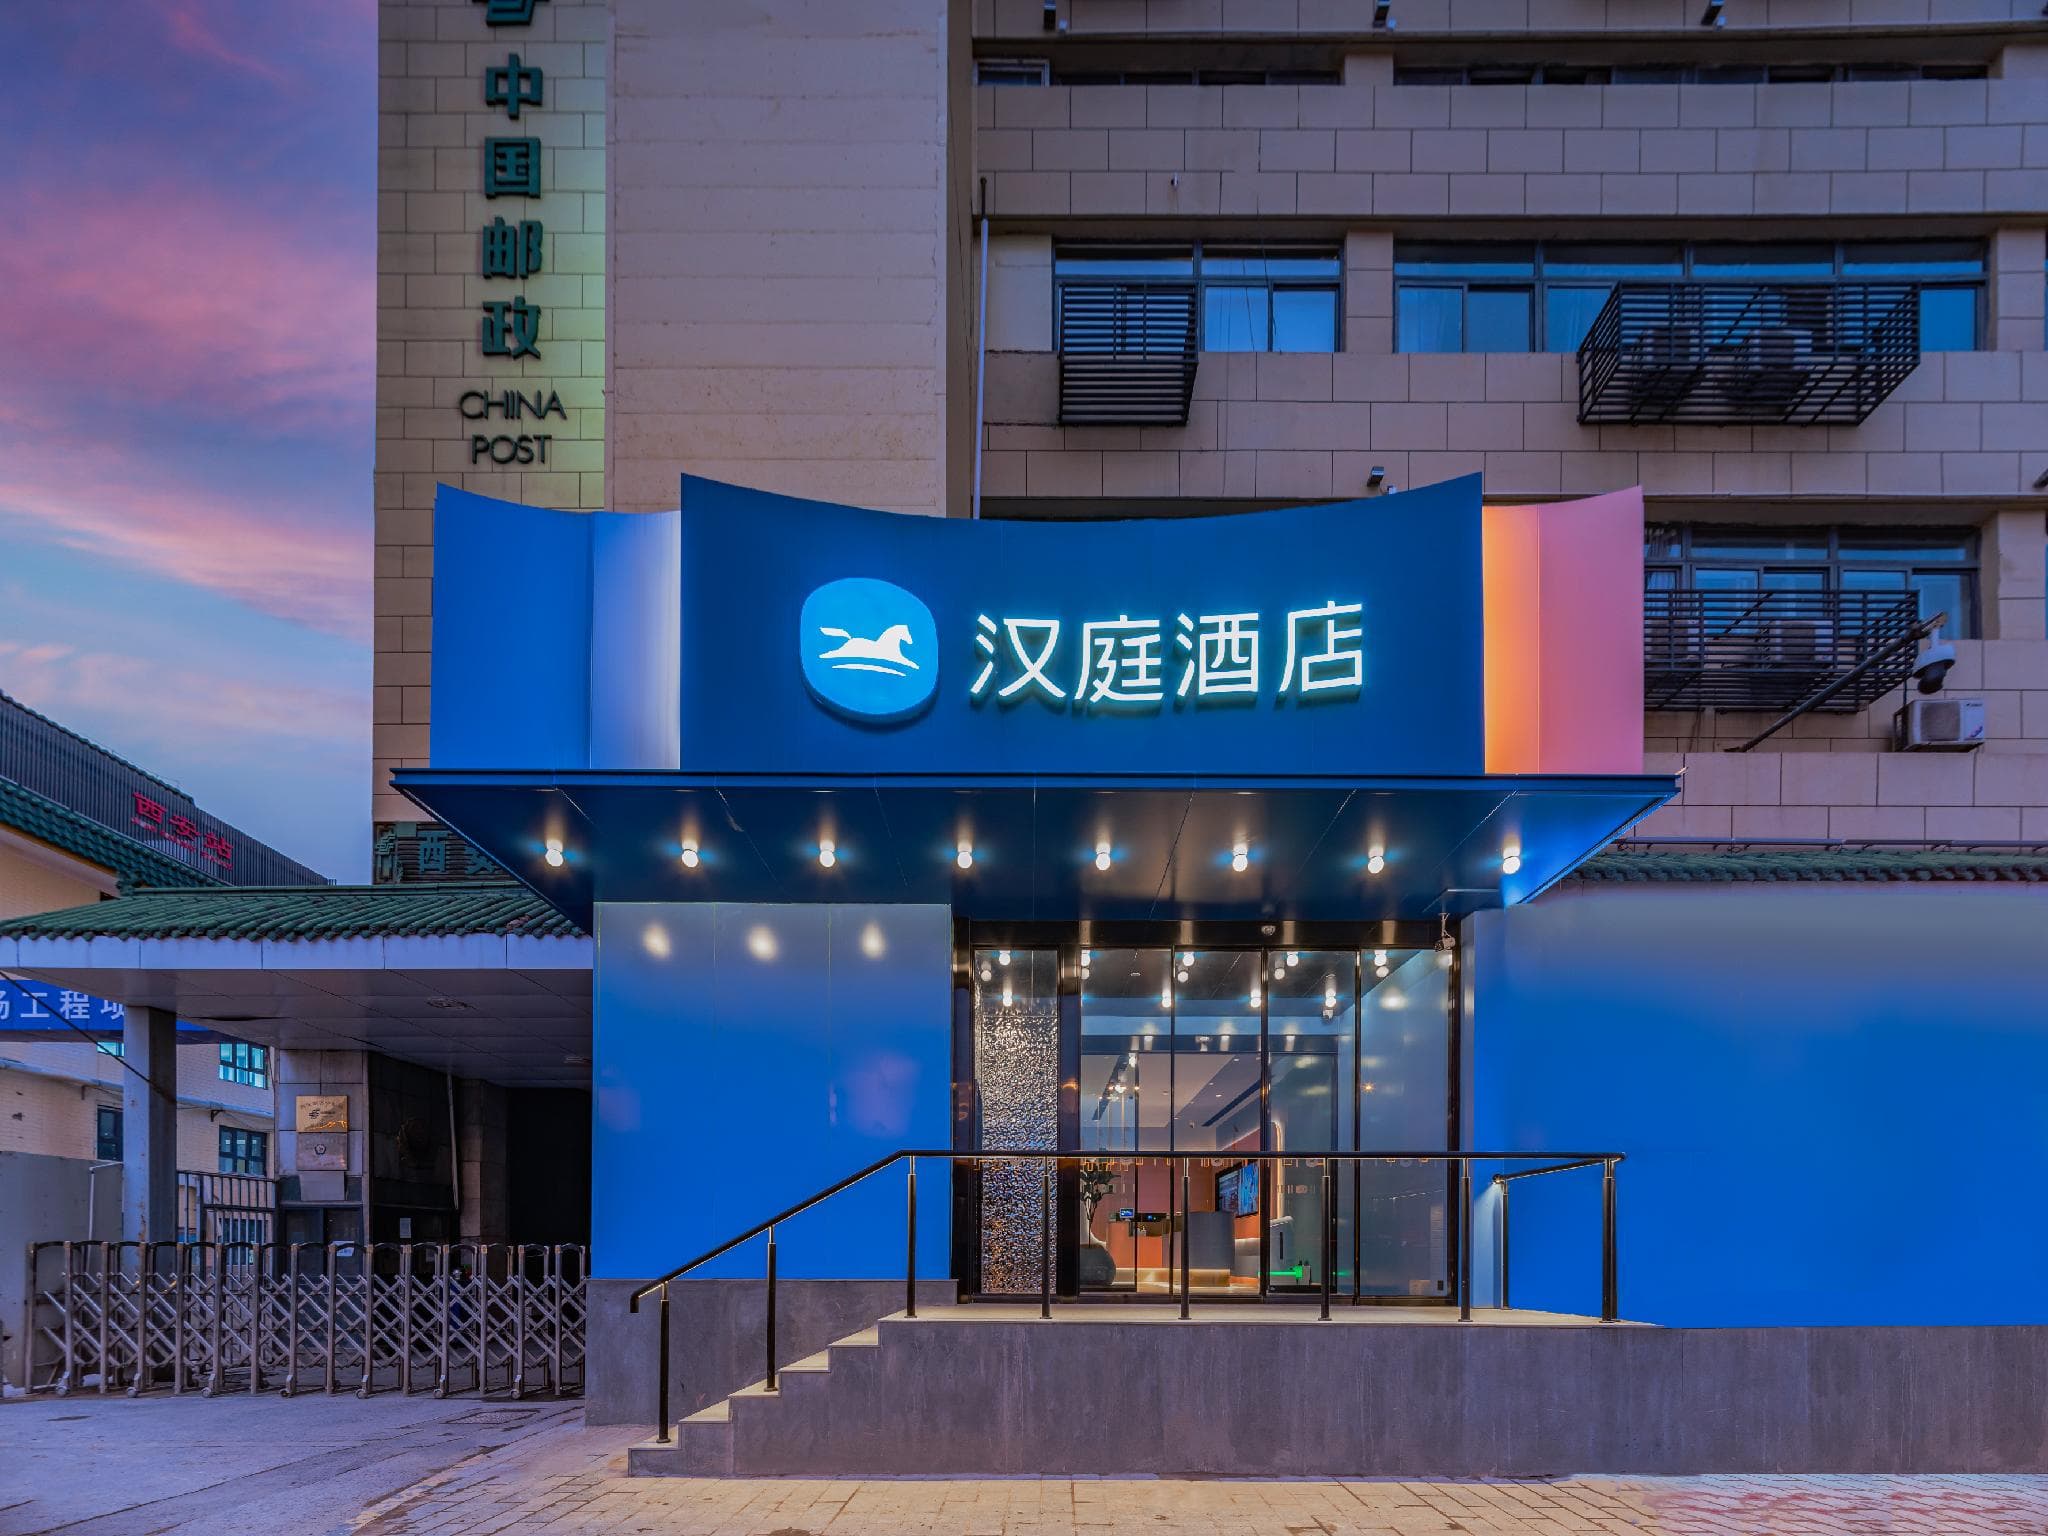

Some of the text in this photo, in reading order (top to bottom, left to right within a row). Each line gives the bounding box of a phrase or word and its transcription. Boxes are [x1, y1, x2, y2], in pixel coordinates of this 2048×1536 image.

[481, 53, 544, 360] 中国邮政
[459, 389, 568, 420] CHINA
[472, 434, 552, 465] POST
[970, 601, 1363, 703] 汉庭酒店
[132, 792, 234, 860] 西安站
